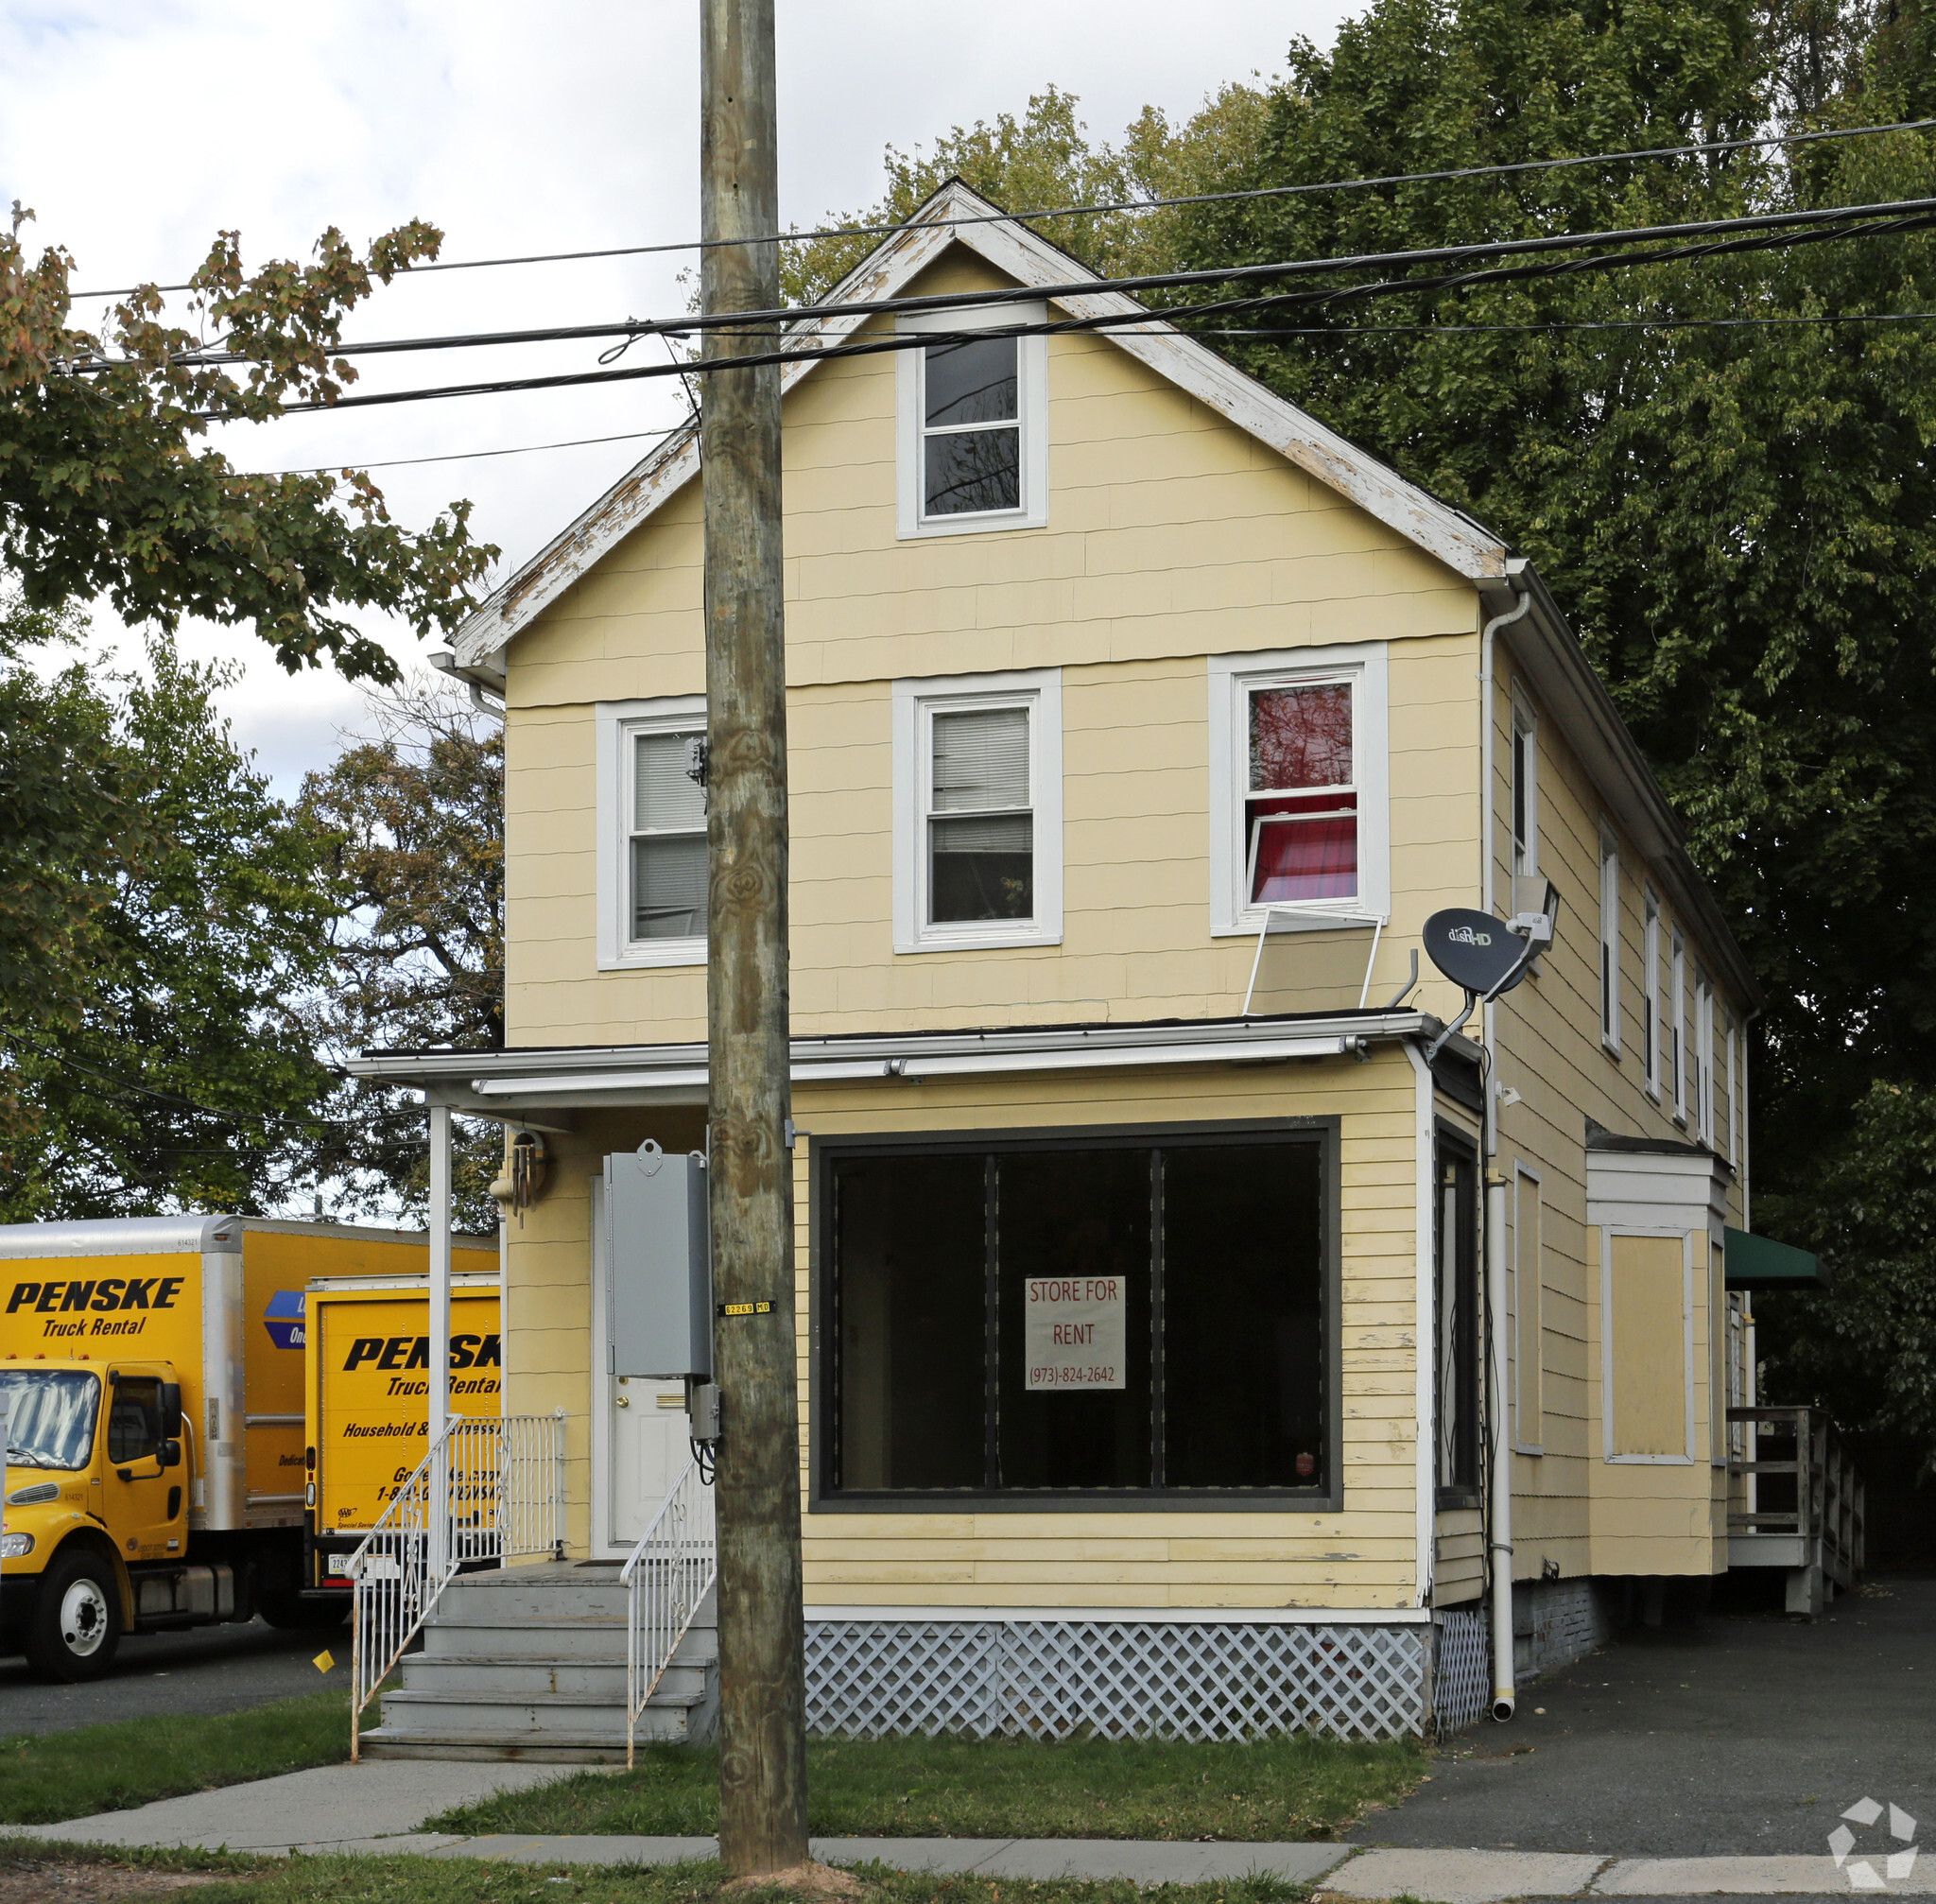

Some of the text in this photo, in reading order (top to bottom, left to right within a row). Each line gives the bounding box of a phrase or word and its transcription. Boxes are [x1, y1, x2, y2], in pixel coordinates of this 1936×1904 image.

[5, 1277, 185, 1314] PENSKE
[1030, 1280, 1117, 1302] STORE FOR
[726, 1305, 752, 1314] 62269
[43, 1317, 147, 1337] Truck Rental
[1054, 1324, 1095, 1344] RENT
[1029, 1367, 1115, 1385] (973)-824-2642
[343, 1422, 416, 1437] Household
[417, 1421, 429, 1436] &
